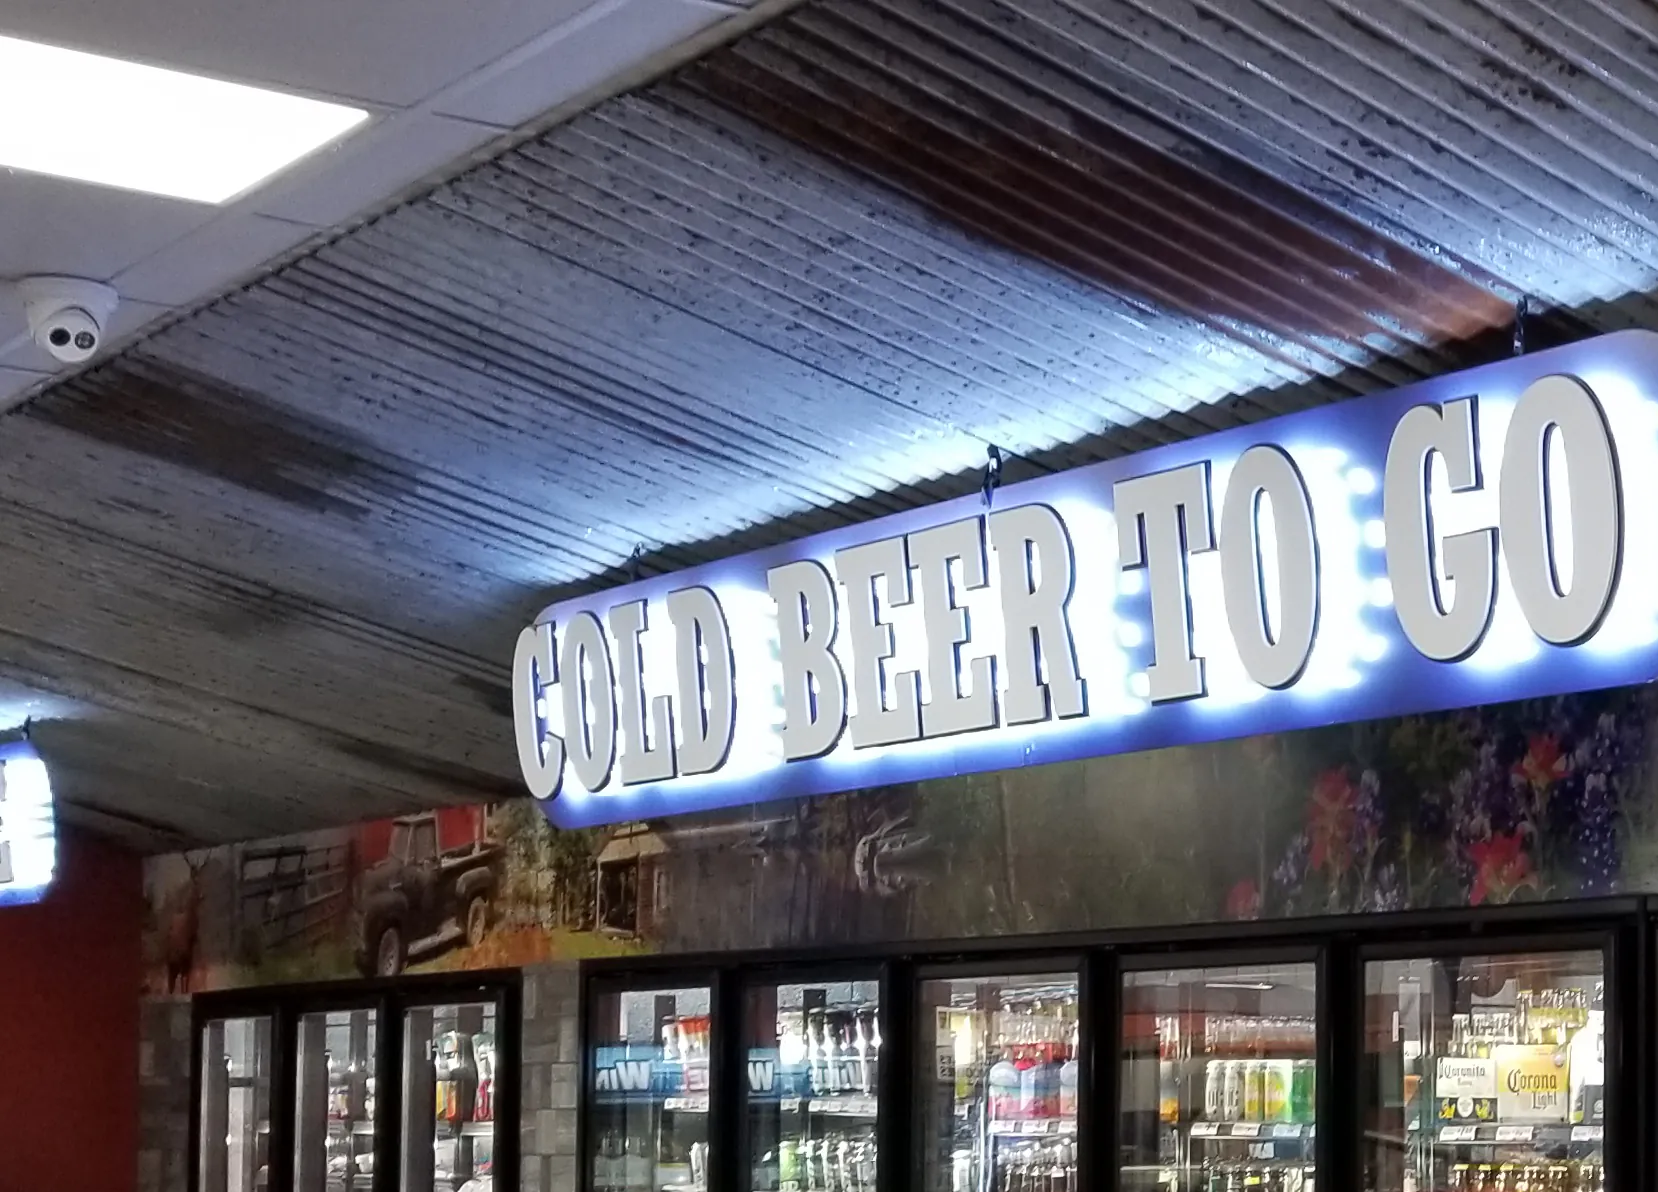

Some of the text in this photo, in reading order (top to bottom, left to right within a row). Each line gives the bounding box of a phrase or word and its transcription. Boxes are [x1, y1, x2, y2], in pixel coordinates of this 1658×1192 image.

[511, 373, 1625, 801] COLD BEER TO GO
[1507, 1069, 1557, 1094] Corona
[1531, 1091, 1557, 1110] Light
